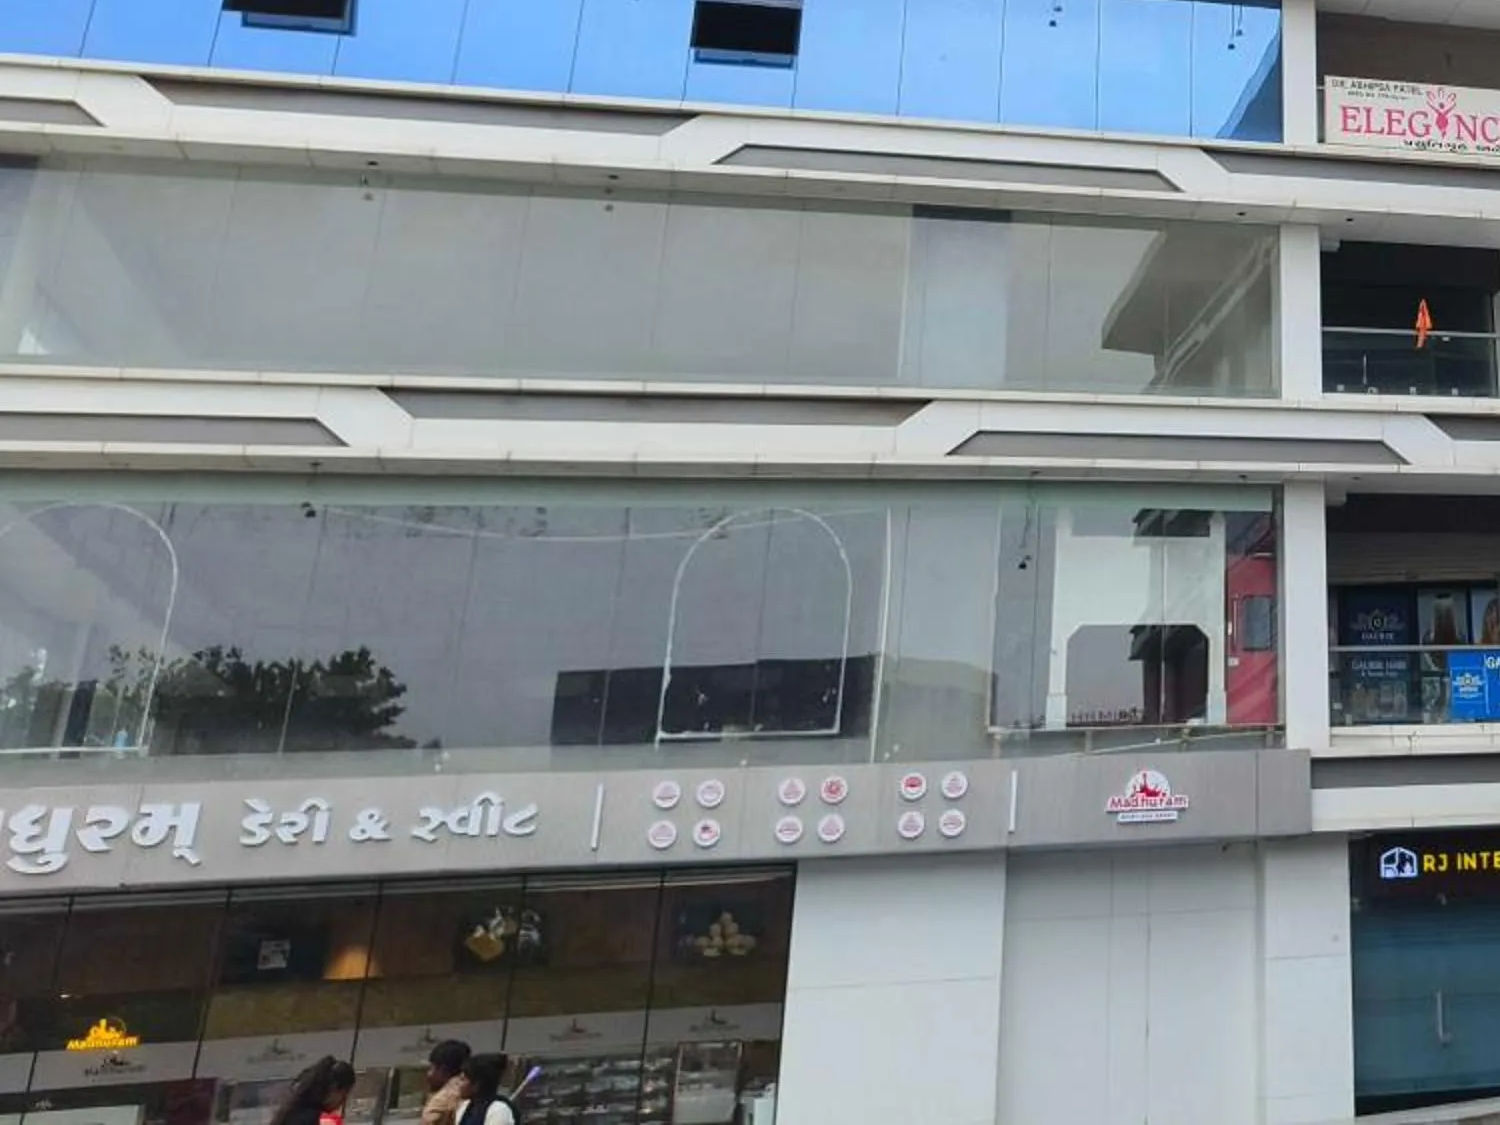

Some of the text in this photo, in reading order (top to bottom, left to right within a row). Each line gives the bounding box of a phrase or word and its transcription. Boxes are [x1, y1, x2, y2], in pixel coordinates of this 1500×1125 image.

[1109, 795, 1187, 809] Madhuram
[0, 802, 203, 875] ધુરમ્
[238, 794, 332, 846] ડેરી
[348, 807, 391, 843] &
[1422, 853, 1447, 873] RJ
